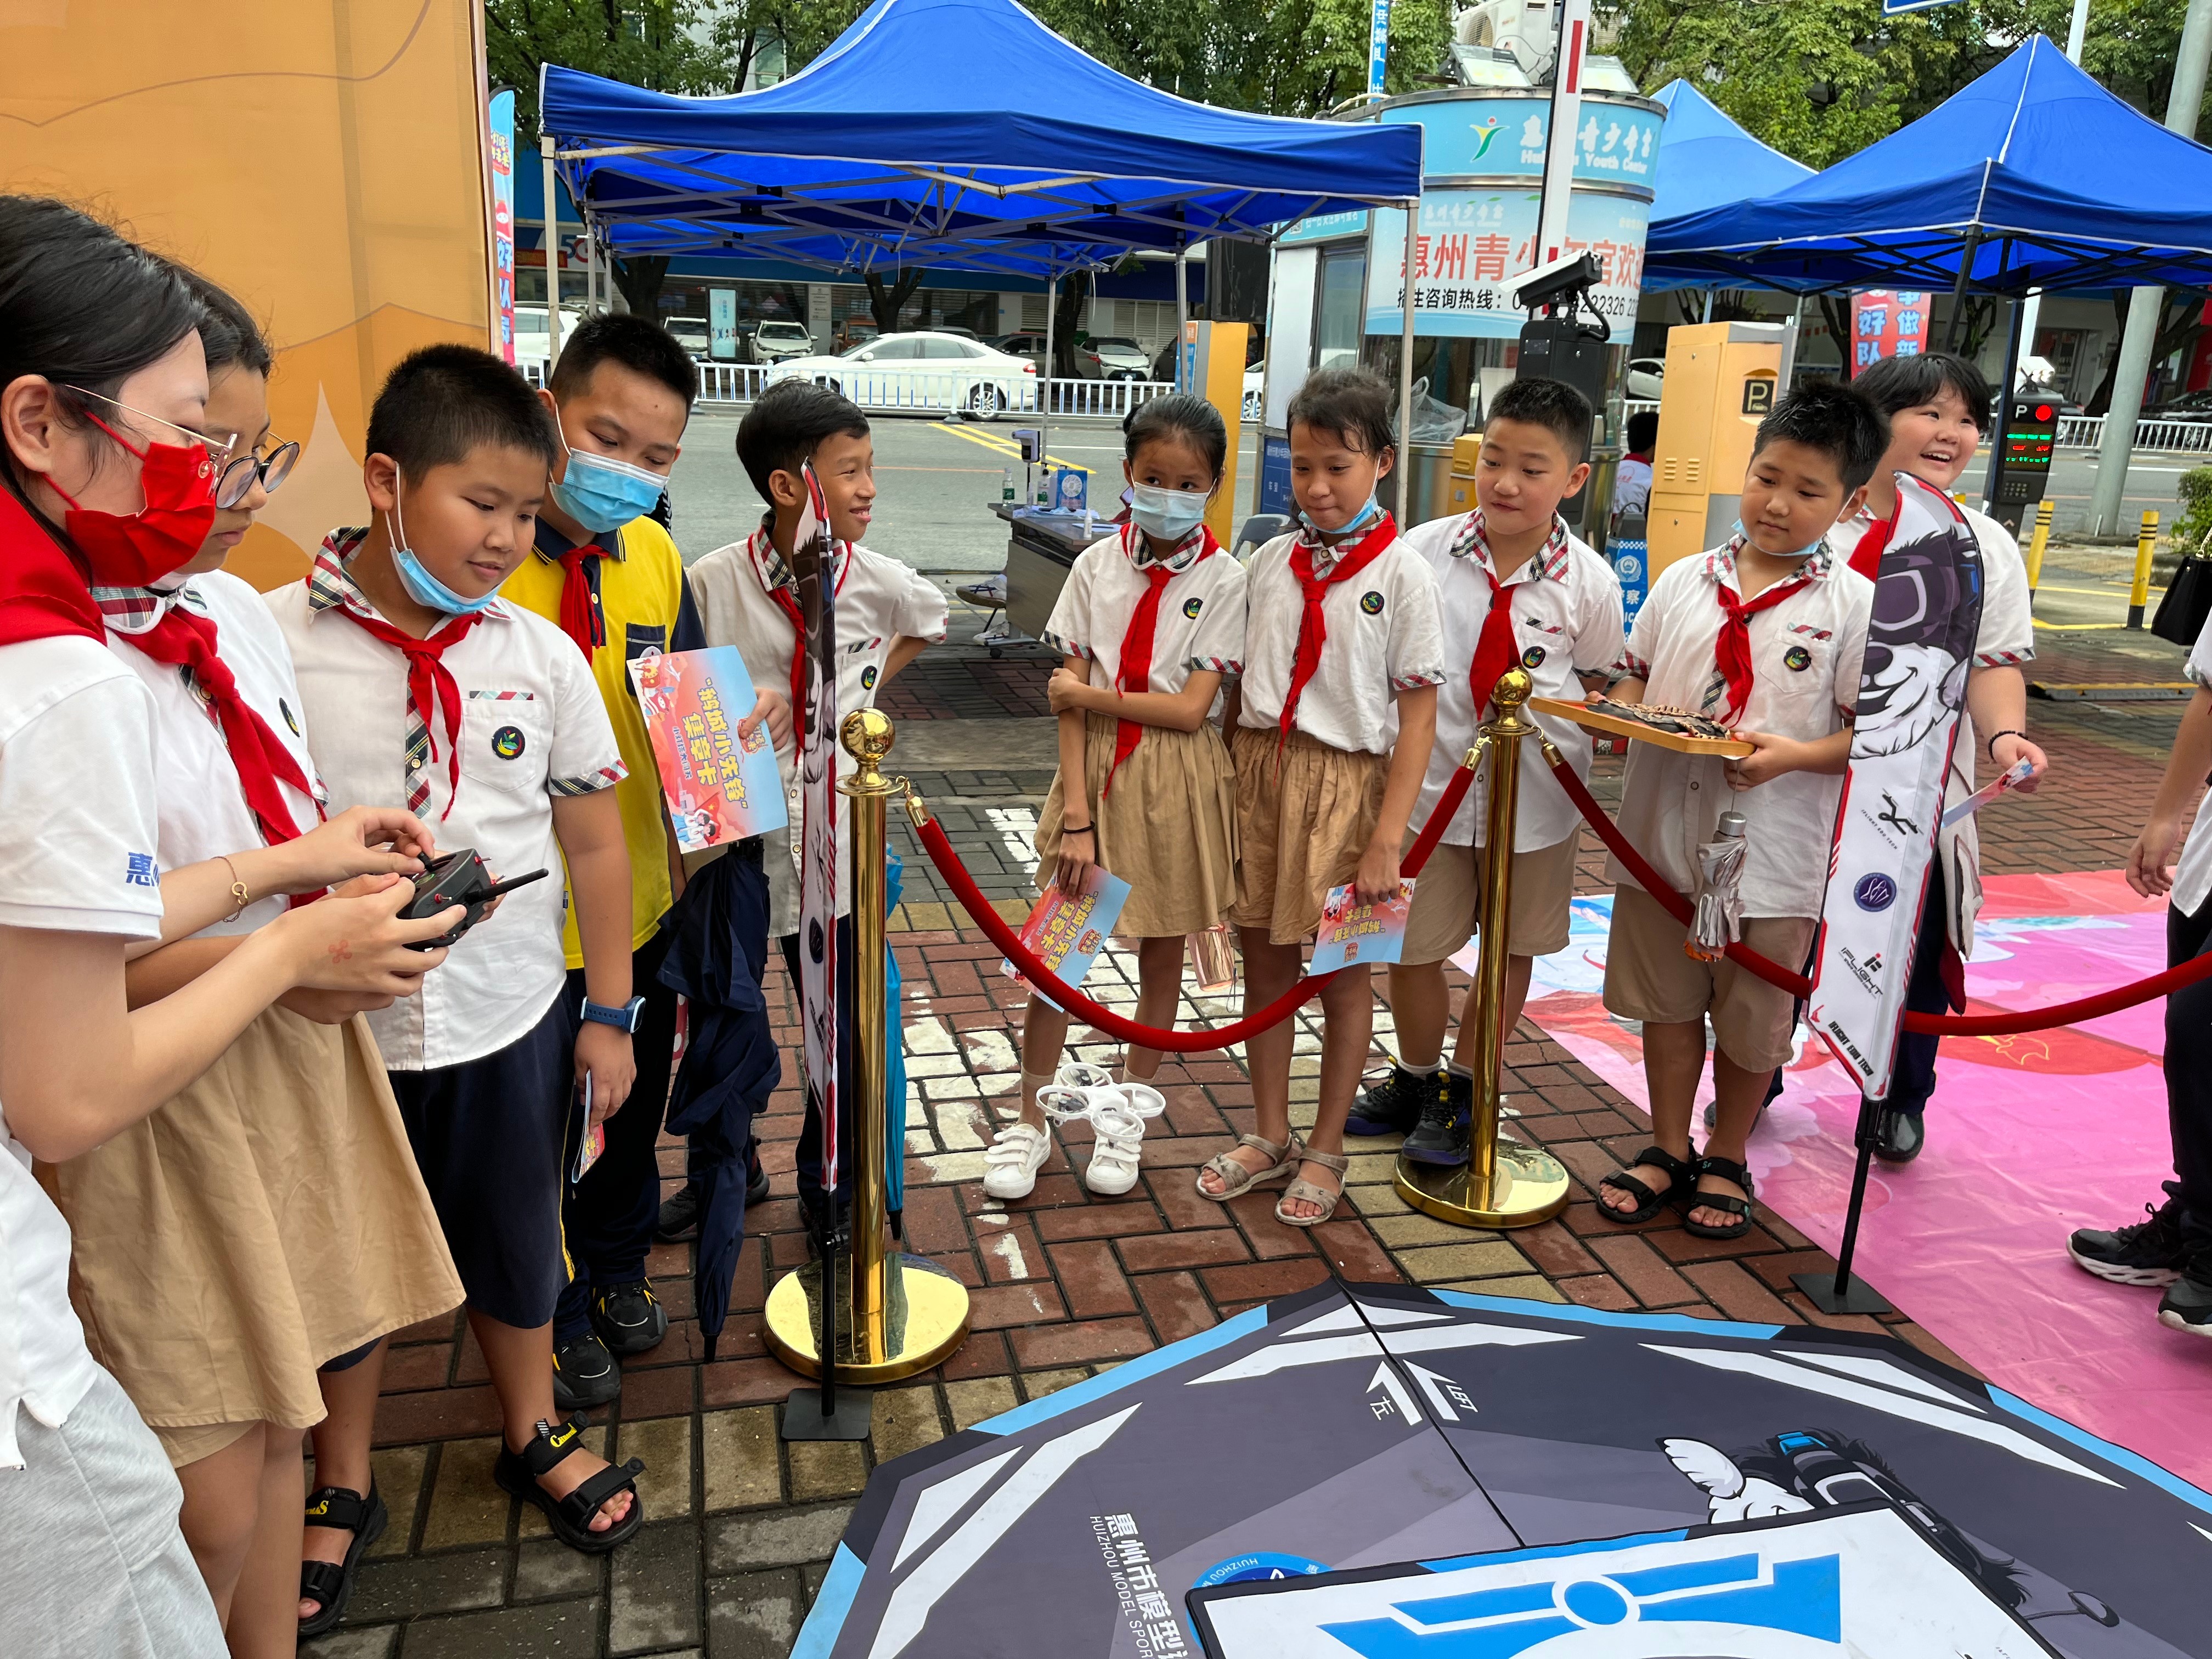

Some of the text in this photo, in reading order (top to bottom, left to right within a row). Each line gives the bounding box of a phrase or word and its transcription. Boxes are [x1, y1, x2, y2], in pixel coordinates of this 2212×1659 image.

[2015, 404, 2028, 419] P
[681, 712, 718, 786] 集章卡
[1040, 900, 1076, 951] 集章卡
[1369, 1396, 1395, 1421] 左
[1445, 1384, 1479, 1413] LEFT
[1210, 1558, 1259, 1582] HUIZHOU
[1090, 1515, 1155, 1659] HUIZHOU MODEL SPOR
